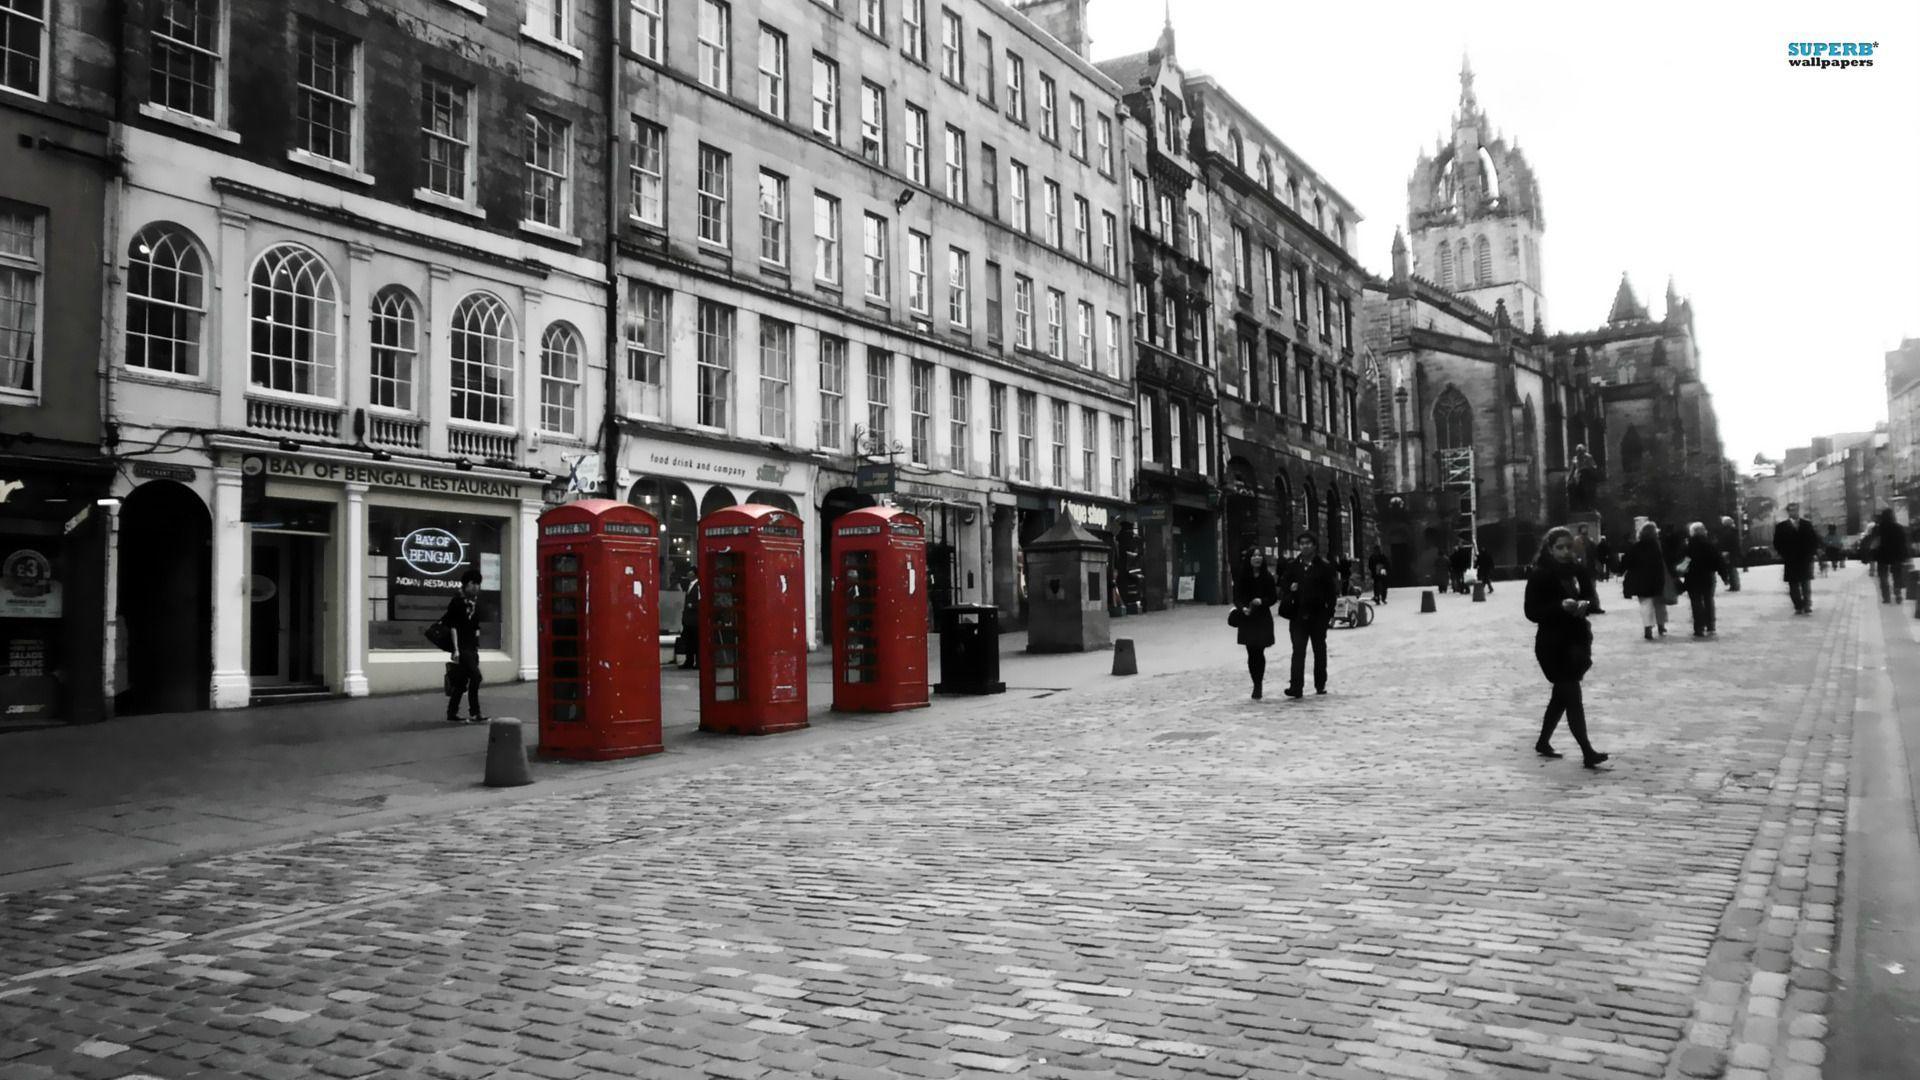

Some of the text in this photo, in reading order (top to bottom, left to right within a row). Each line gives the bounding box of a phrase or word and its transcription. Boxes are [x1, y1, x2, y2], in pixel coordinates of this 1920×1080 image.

[650, 453, 669, 465] food
[672, 457, 693, 468] drink
[697, 461, 710, 471] and
[713, 464, 746, 477] company
[269, 457, 521, 498] BAY OF BENGAL RESTAURANT
[1087, 503, 1107, 530] shop
[414, 534, 451, 547] BAY OF
[409, 548, 458, 565] BENGAL
[424, 578, 463, 589] RESTAURAN
